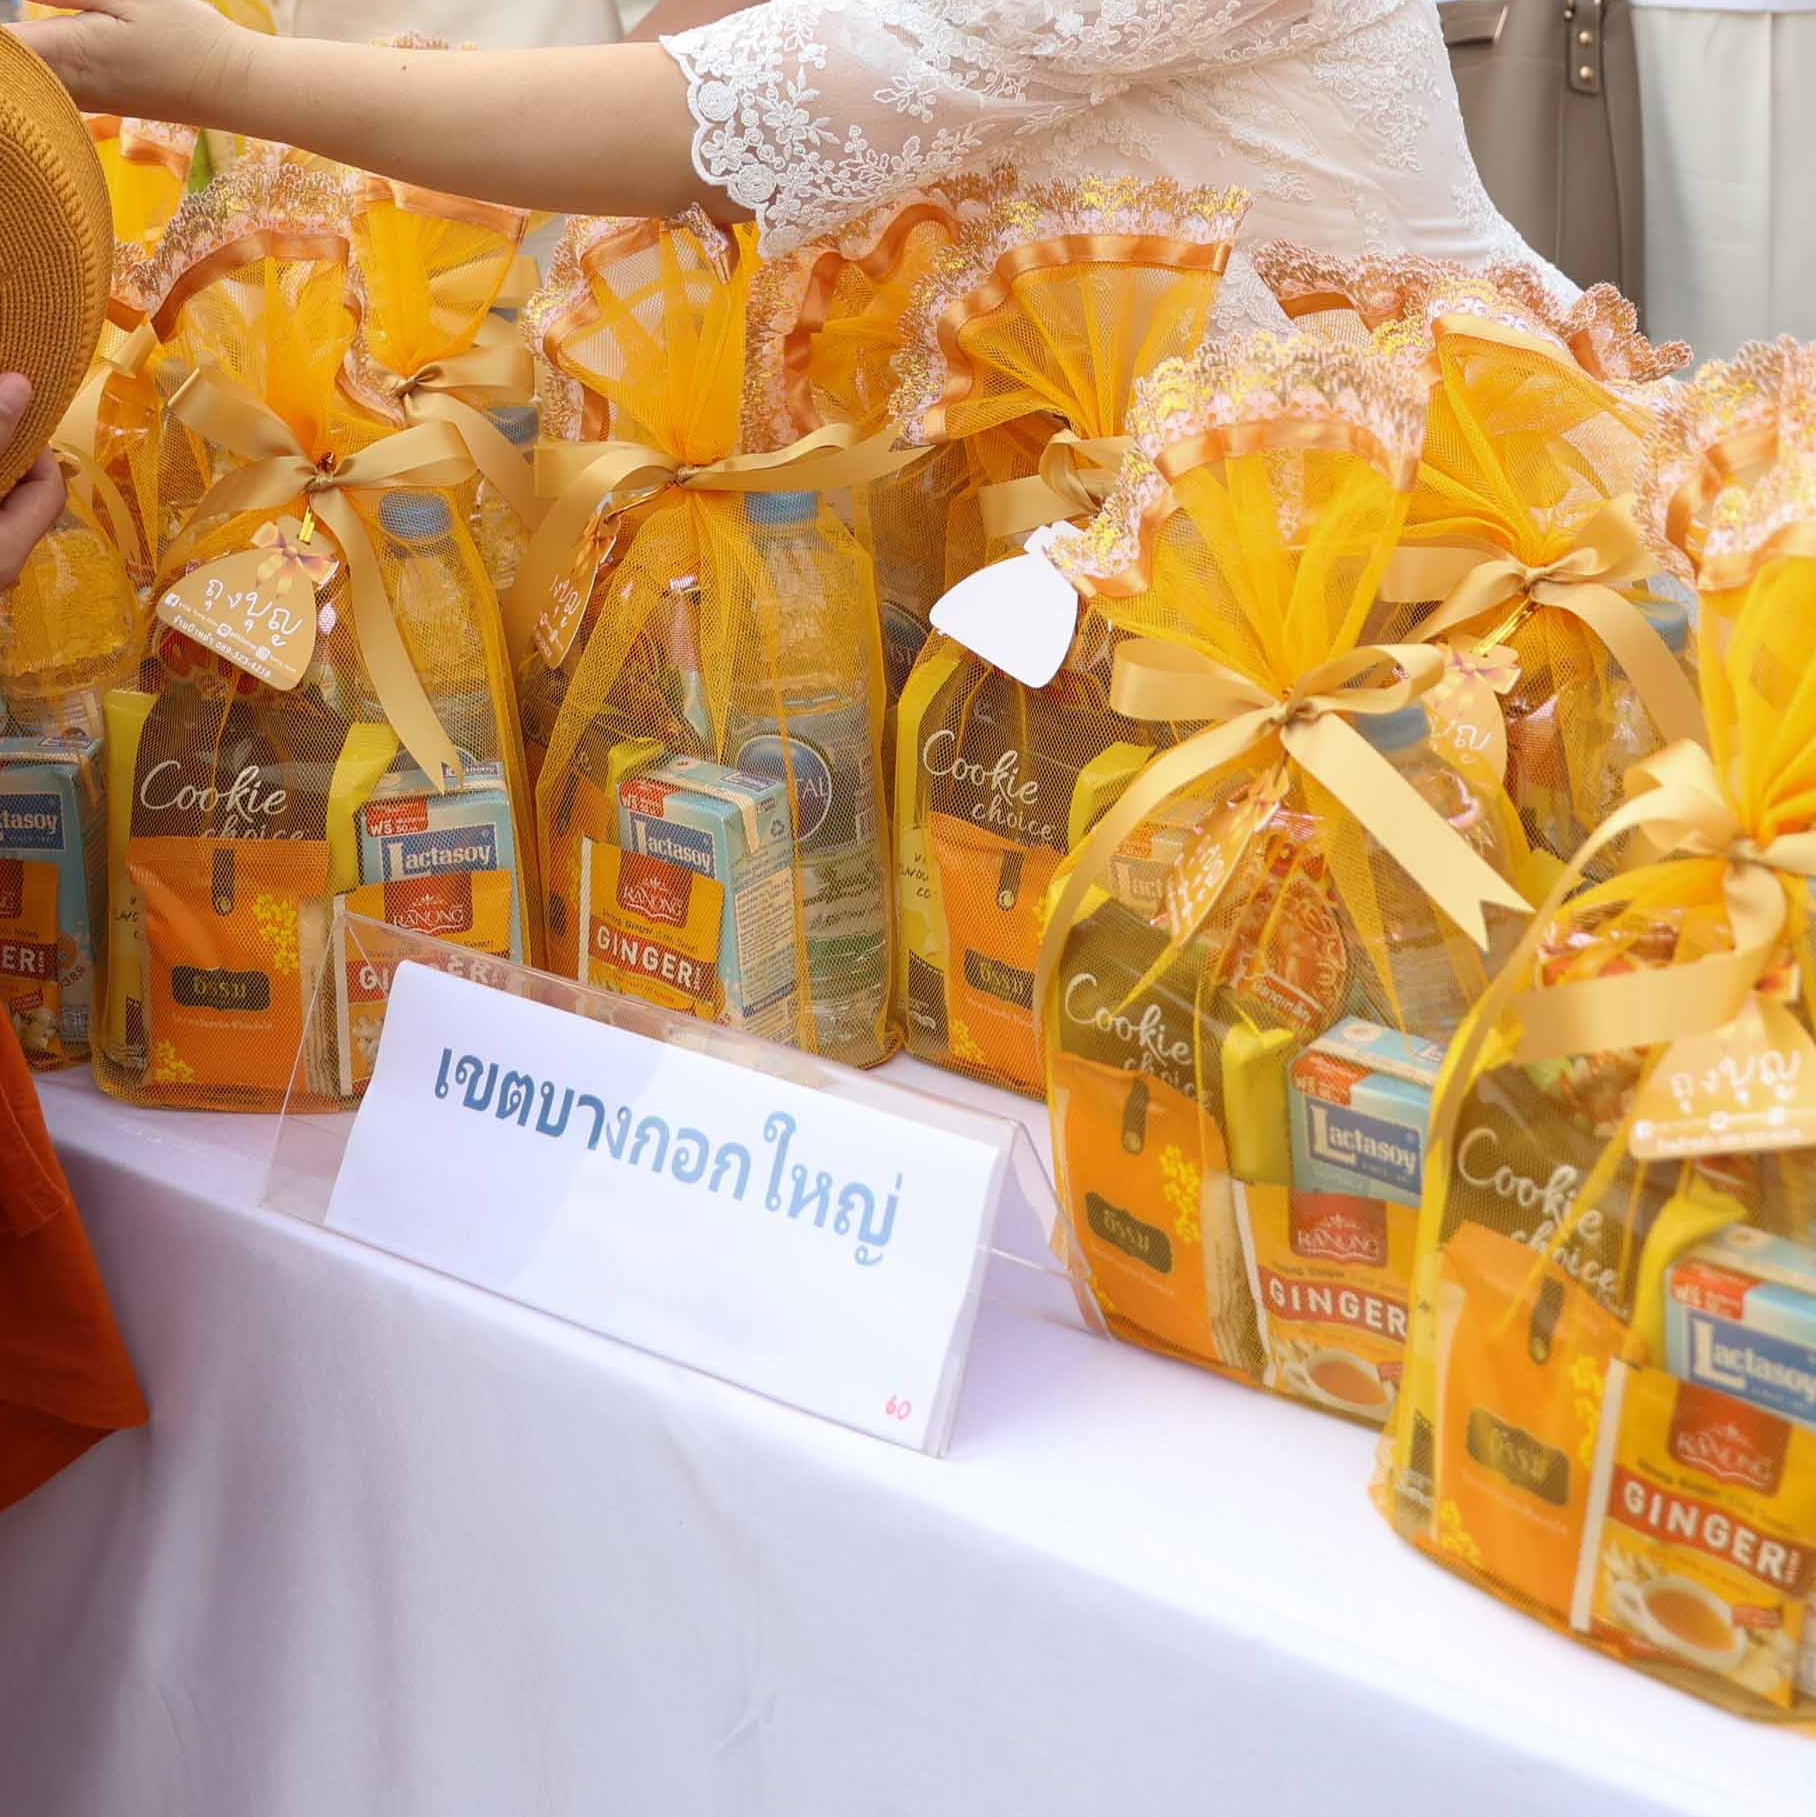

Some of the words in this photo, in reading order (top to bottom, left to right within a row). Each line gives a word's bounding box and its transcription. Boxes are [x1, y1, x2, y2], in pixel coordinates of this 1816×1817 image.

[204, 578, 304, 647] ถุงบุญ
[140, 760, 288, 823] Cookie
[922, 729, 1039, 807] Cookie
[633, 820, 713, 874] Lactasoy
[972, 794, 1054, 839] choice
[387, 842, 492, 881] Lactasoy
[597, 925, 693, 988] GINGER
[1065, 972, 1193, 1068] Cookie
[433, 1045, 904, 1268] เขตบางกอกใหญ่
[1310, 1104, 1417, 1176] Lactasoy
[1268, 1277, 1407, 1337] GINGER
[882, 1392, 913, 1422] 60
[1622, 1482, 1788, 1582] GINGER
